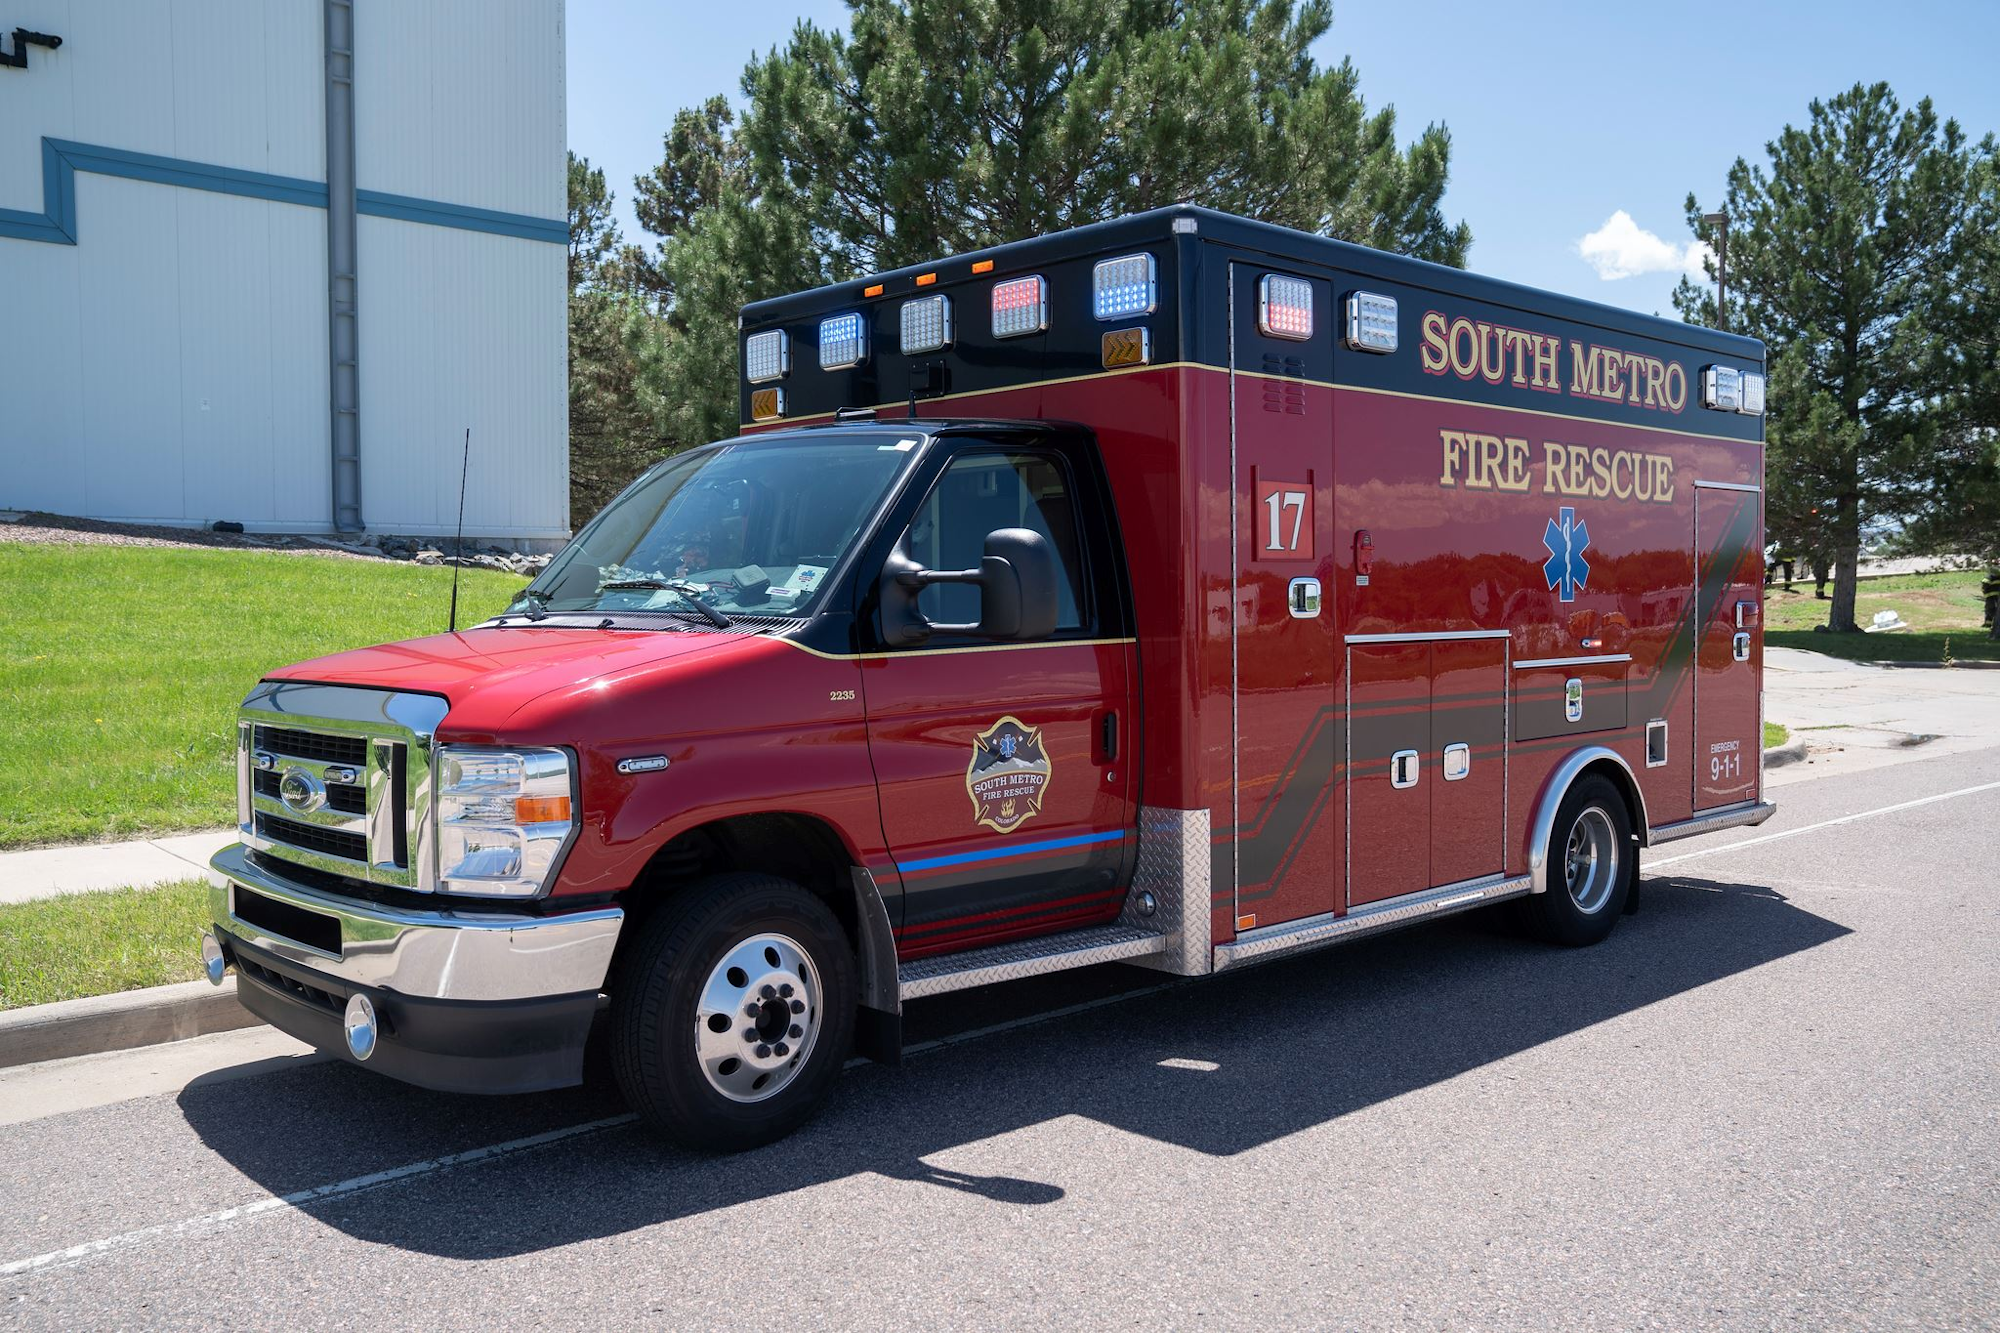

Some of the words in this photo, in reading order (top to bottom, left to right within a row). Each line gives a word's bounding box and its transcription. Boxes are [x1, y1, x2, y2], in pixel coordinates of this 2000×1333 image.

[1421, 310, 1561, 393] SOUTH
[1570, 339, 1687, 413] METRO
[1439, 430, 1531, 491] FIRE
[1543, 442, 1675, 502] RESCUE
[1265, 490, 1307, 551] 17
[830, 690, 855, 701] 2235
[1711, 740, 1740, 753] EMERGENCY
[1711, 753, 1740, 781] 9-1-1
[974, 776, 1007, 794] SOUTH
[1010, 774, 1043, 785] METRO
[983, 790, 1002, 801] FIRE
[1004, 786, 1035, 798] RESCUE
[995, 814, 1020, 824] COLORADO
